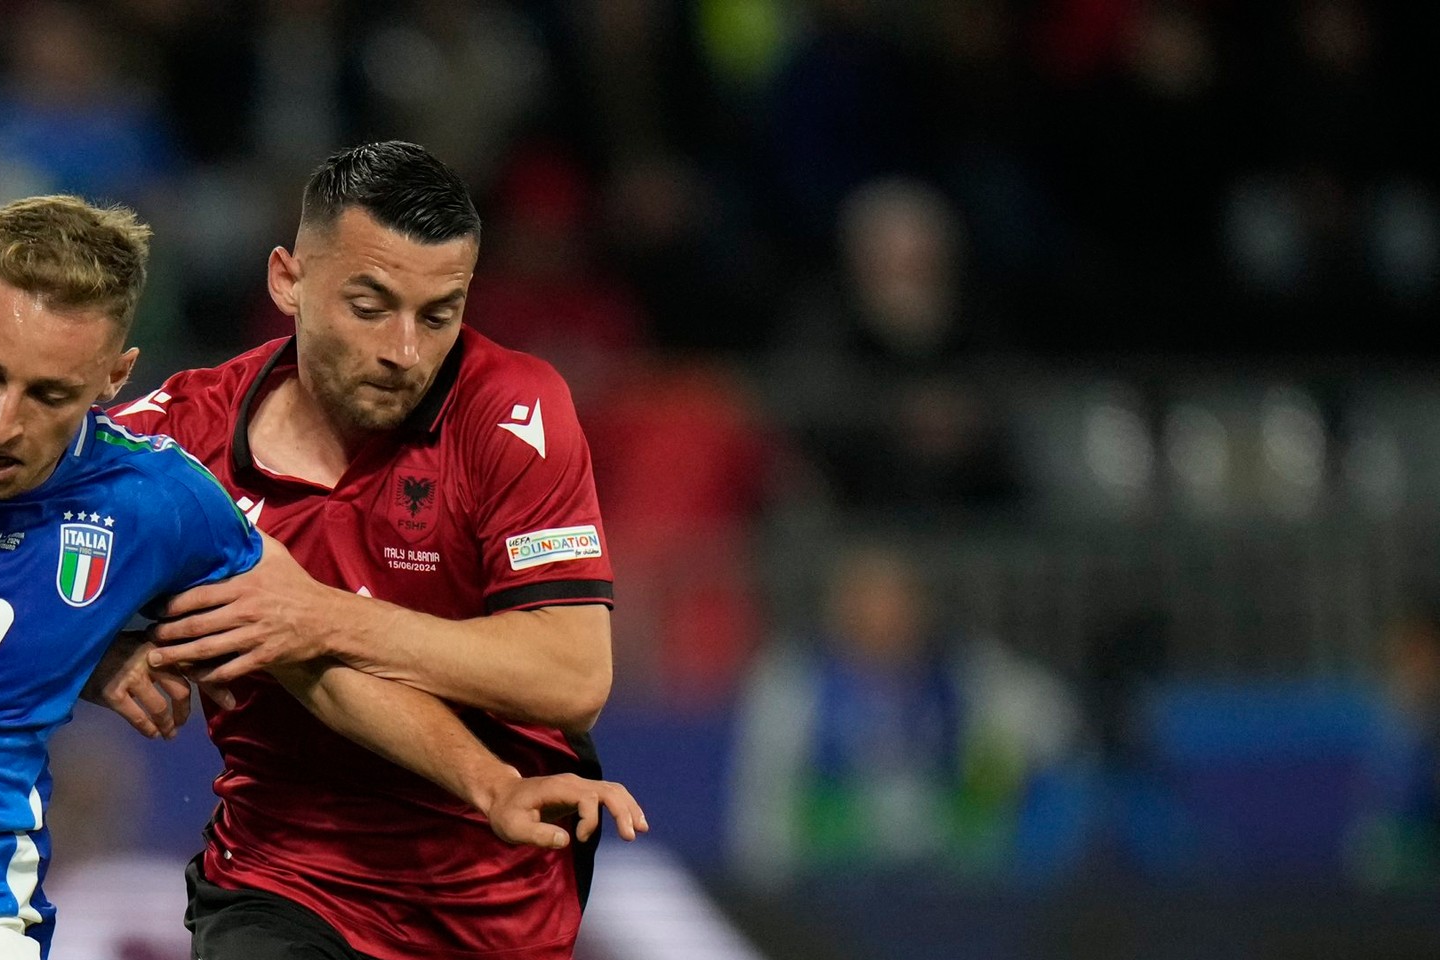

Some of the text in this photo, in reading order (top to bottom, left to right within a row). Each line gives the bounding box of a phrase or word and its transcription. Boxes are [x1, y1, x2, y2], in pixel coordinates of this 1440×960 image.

[397, 519, 428, 530] FSHF
[64, 529, 108, 551] ITALIA
[509, 536, 531, 547] UEFA
[510, 535, 599, 559] FOUNDATION
[384, 547, 440, 563] ITALY ALBANIA
[388, 560, 436, 572] 15/06/2024
